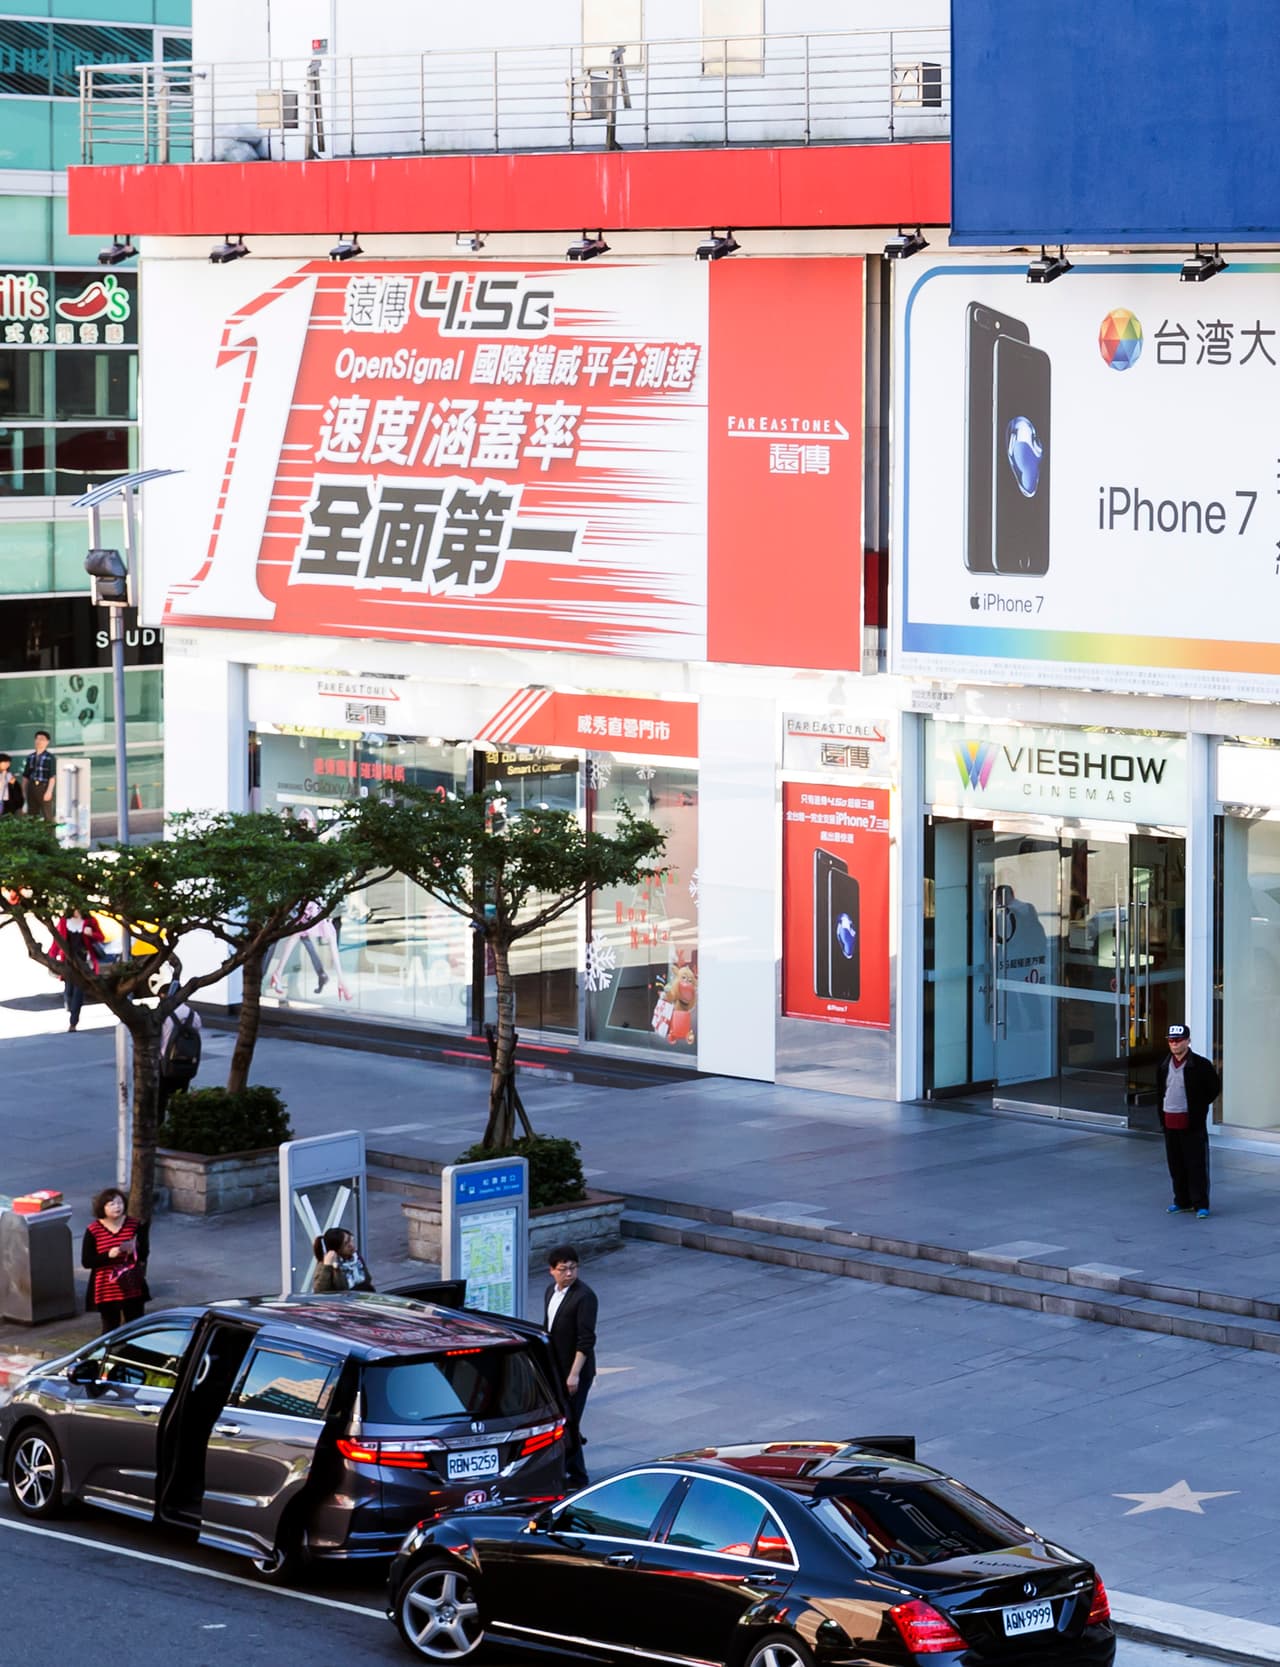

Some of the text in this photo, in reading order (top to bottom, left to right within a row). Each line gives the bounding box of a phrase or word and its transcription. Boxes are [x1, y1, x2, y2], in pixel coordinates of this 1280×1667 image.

[346, 277, 555, 331] 遠傳 4.5G
[335, 344, 698, 391] OpenSignal 國際權威平台測速
[315, 396, 582, 471] 速度/涵蓋率
[769, 443, 831, 475] 遠傳
[1098, 486, 1258, 536] iPhone 7
[298, 484, 577, 586] 全面第一
[983, 594, 1045, 614] iPhone 7
[96, 629, 163, 648] SUDI
[577, 714, 671, 741] 威秀直營門市
[507, 764, 531, 775] Smart
[1003, 746, 1167, 785] VIESHOW
[1022, 783, 1132, 804] CINEMAS
[449, 1454, 497, 1474] RBN-5259
[1006, 1606, 1051, 1631] AQN-9999
